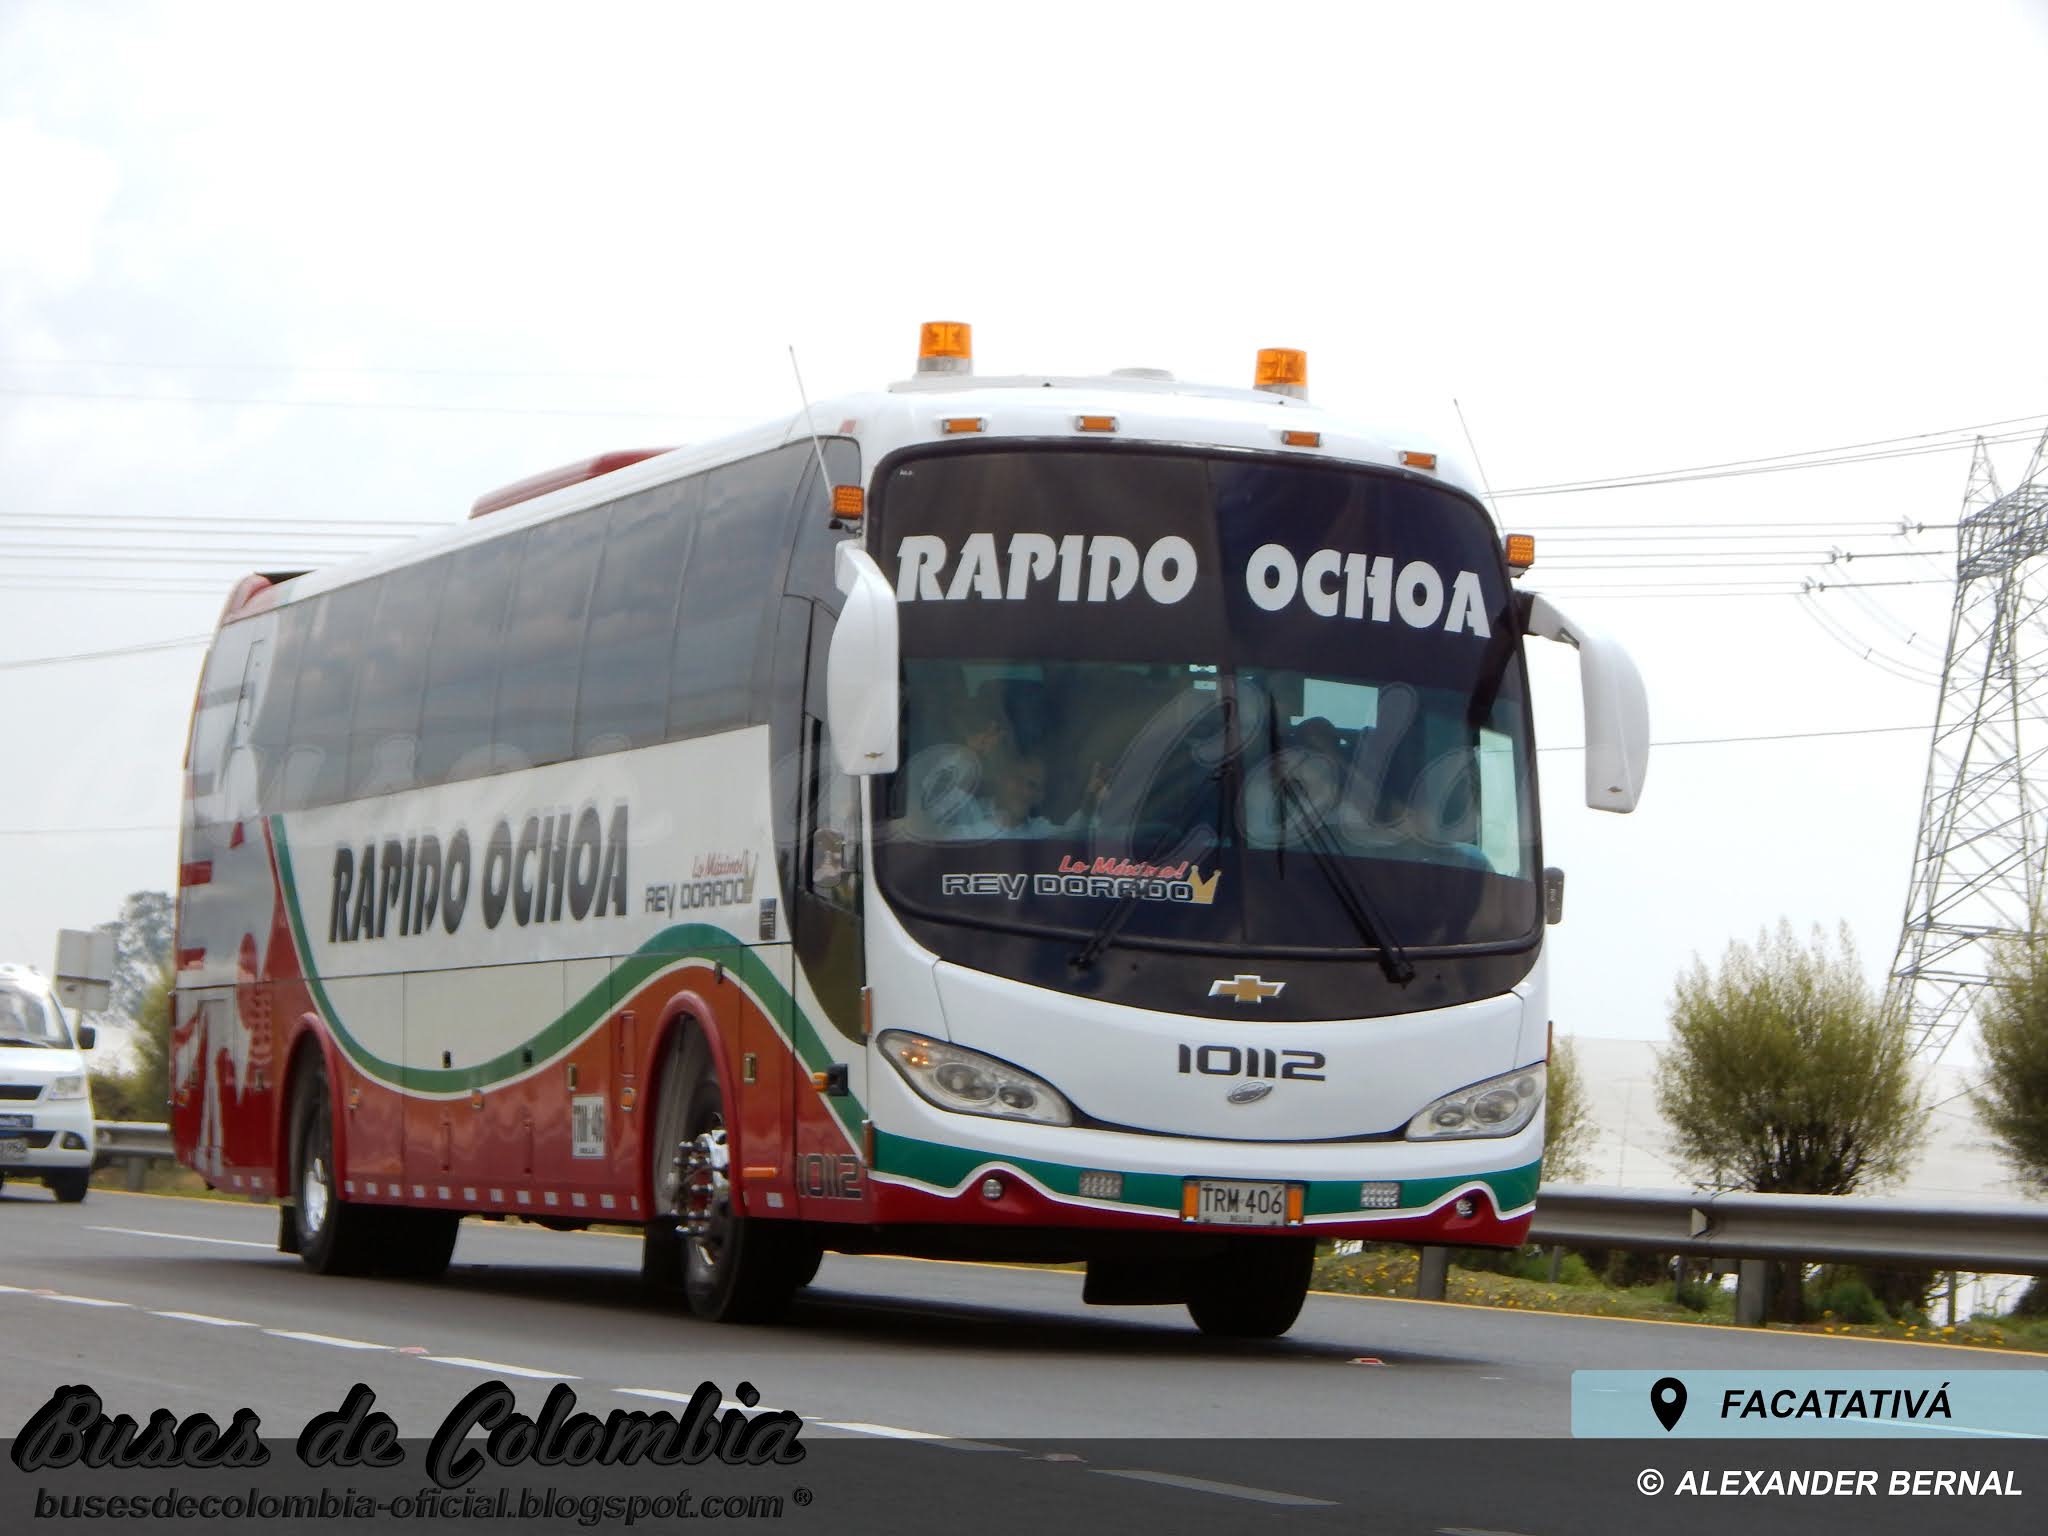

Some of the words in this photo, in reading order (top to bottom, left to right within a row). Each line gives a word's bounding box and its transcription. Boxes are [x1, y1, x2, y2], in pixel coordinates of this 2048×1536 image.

[896, 532, 1198, 604] RAPIDO
[1246, 543, 1491, 638] OCHOA
[328, 828, 471, 942] RAPIDO
[481, 804, 629, 930] OCHOA
[1034, 874, 1194, 902] DORADO
[1178, 1043, 1326, 1081] 10112
[797, 1152, 863, 1200] 10112
[1202, 1186, 1240, 1213] TRM
[1245, 1189, 1283, 1214] 406
